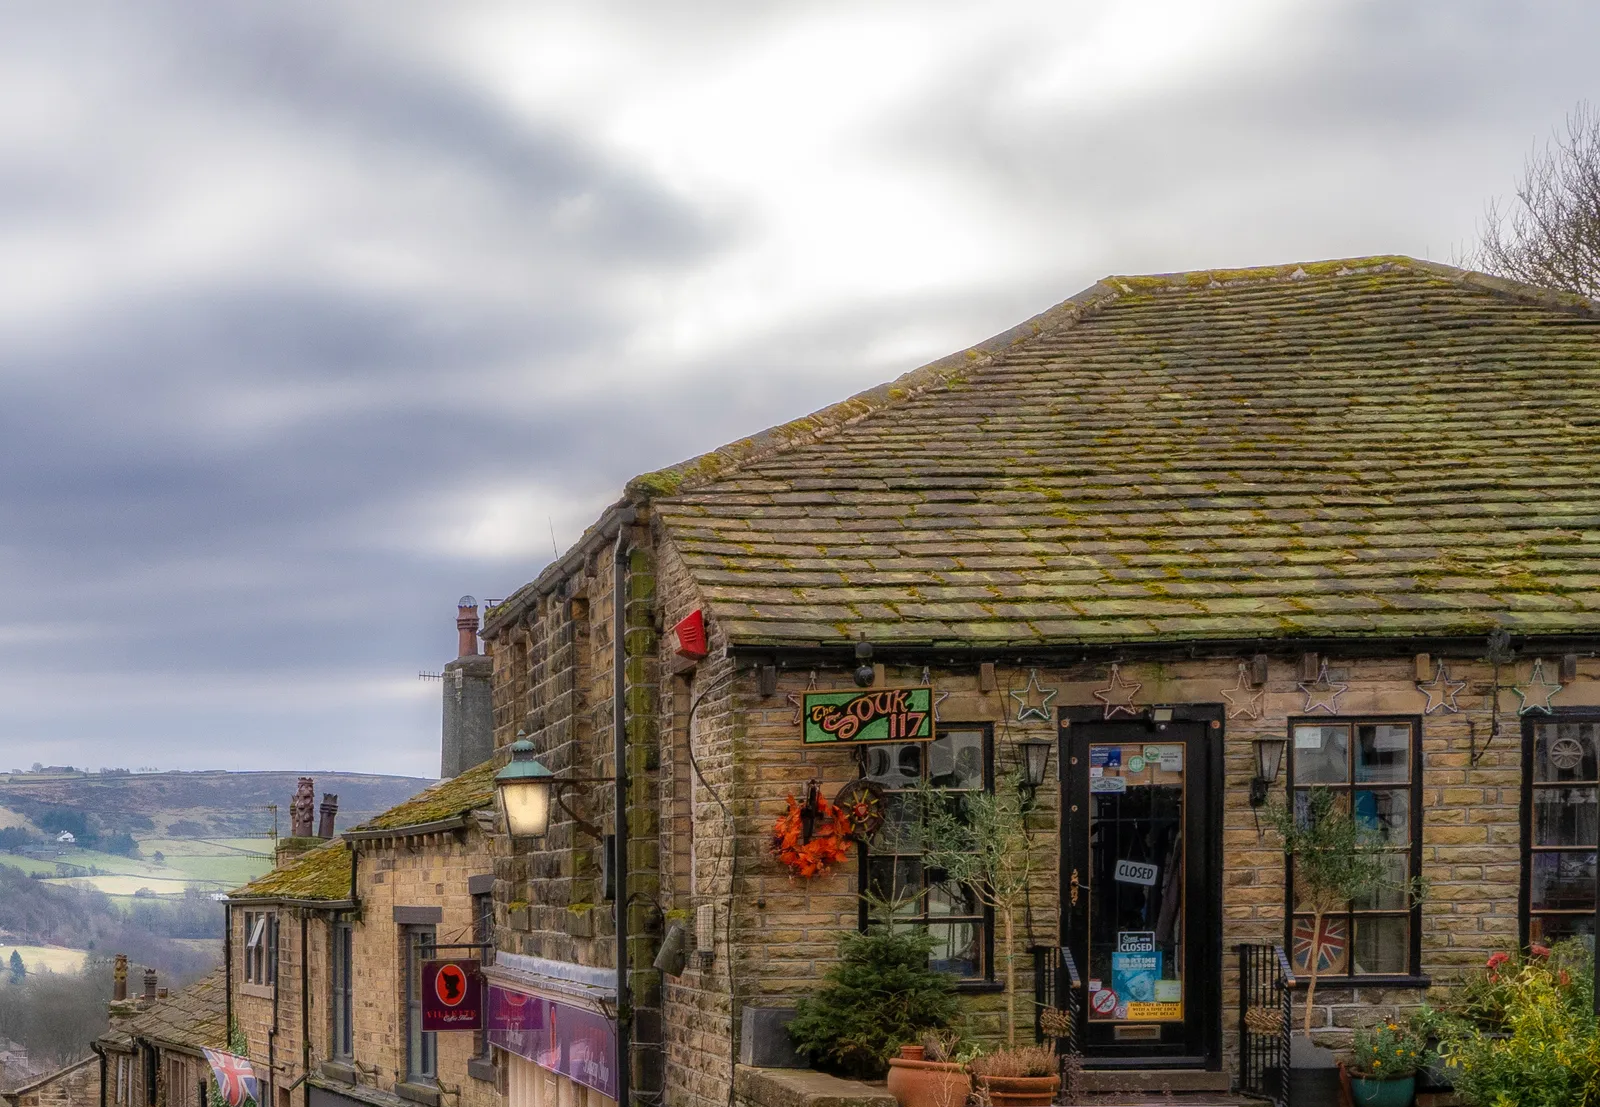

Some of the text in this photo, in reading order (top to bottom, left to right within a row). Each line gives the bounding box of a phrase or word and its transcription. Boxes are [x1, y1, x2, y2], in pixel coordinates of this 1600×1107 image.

[811, 705, 836, 721] The
[890, 712, 926, 738] 117
[1118, 864, 1154, 880] CLOSED
[1120, 943, 1153, 952] CLOSED
[426, 1009, 477, 1019] VILLETTE
